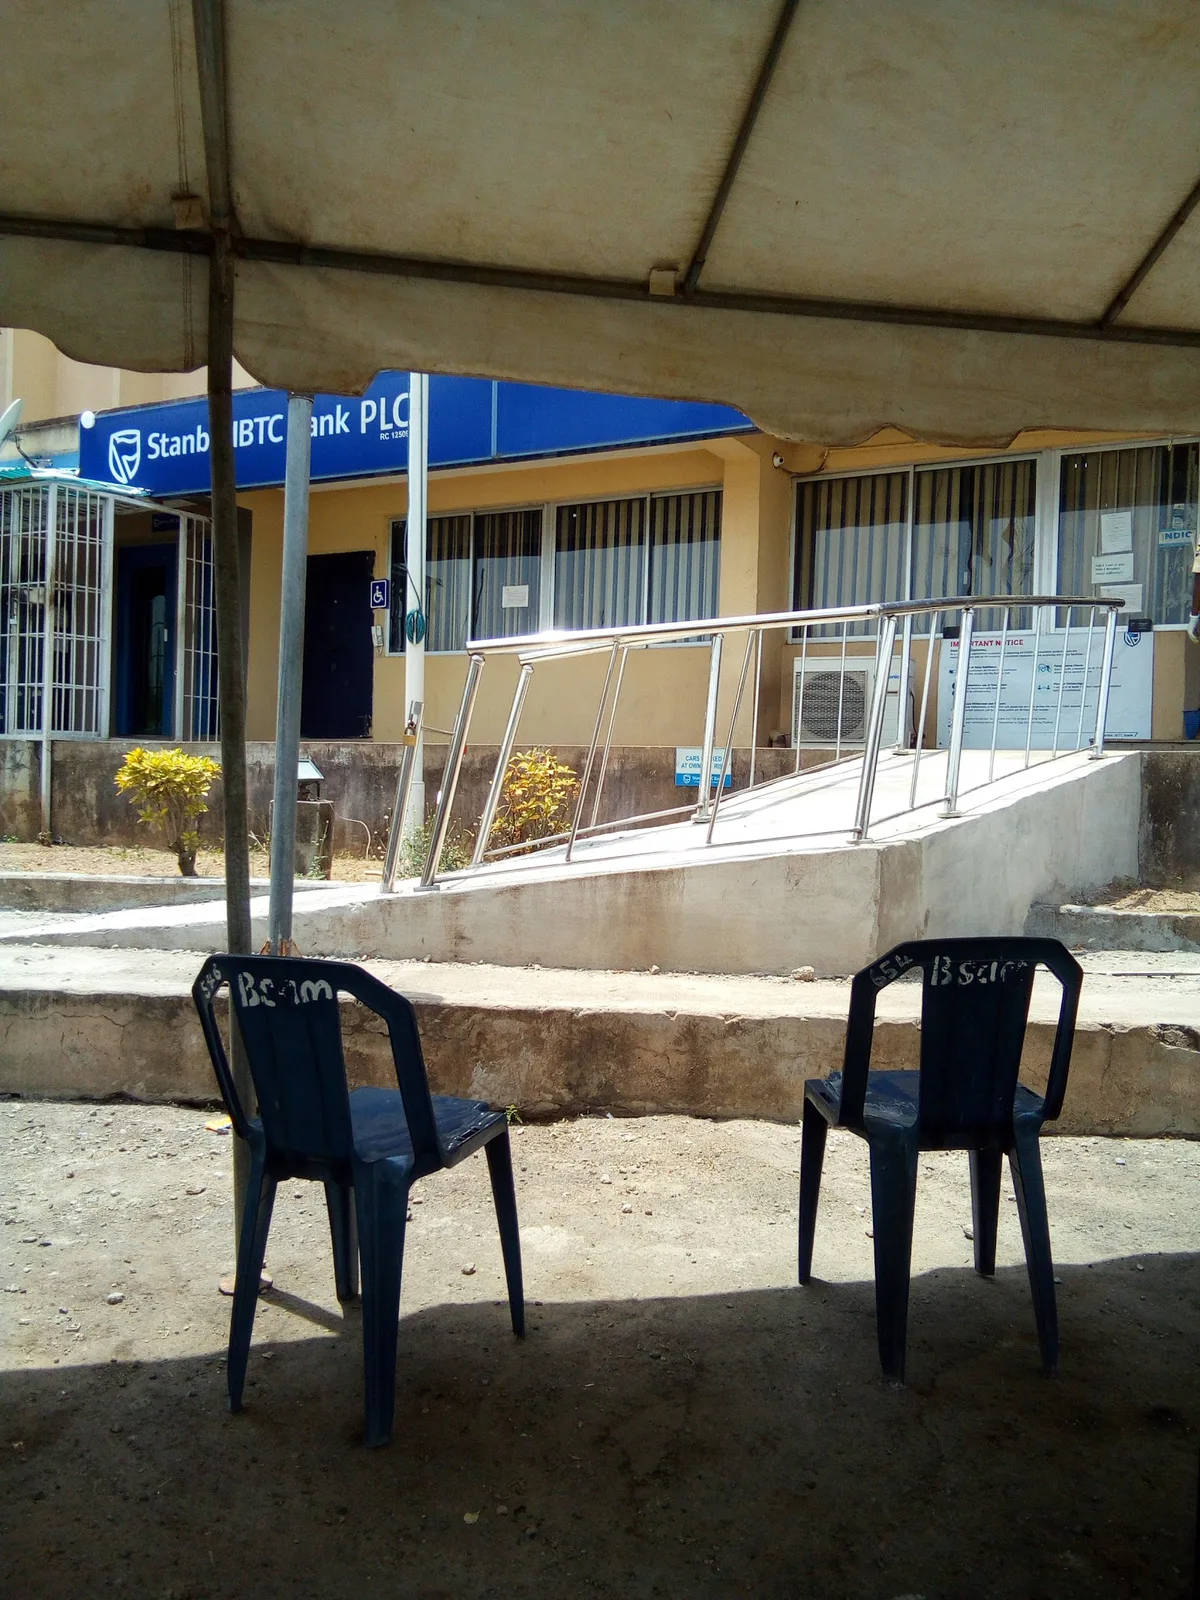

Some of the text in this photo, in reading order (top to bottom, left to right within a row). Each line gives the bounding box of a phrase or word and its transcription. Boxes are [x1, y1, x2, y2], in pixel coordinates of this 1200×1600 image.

[147, 392, 410, 460] Stanb IBTC ank PLC
[380, 432, 390, 441] RC
[1164, 531, 1192, 540] NDIC
[995, 639, 1024, 647] NTICE
